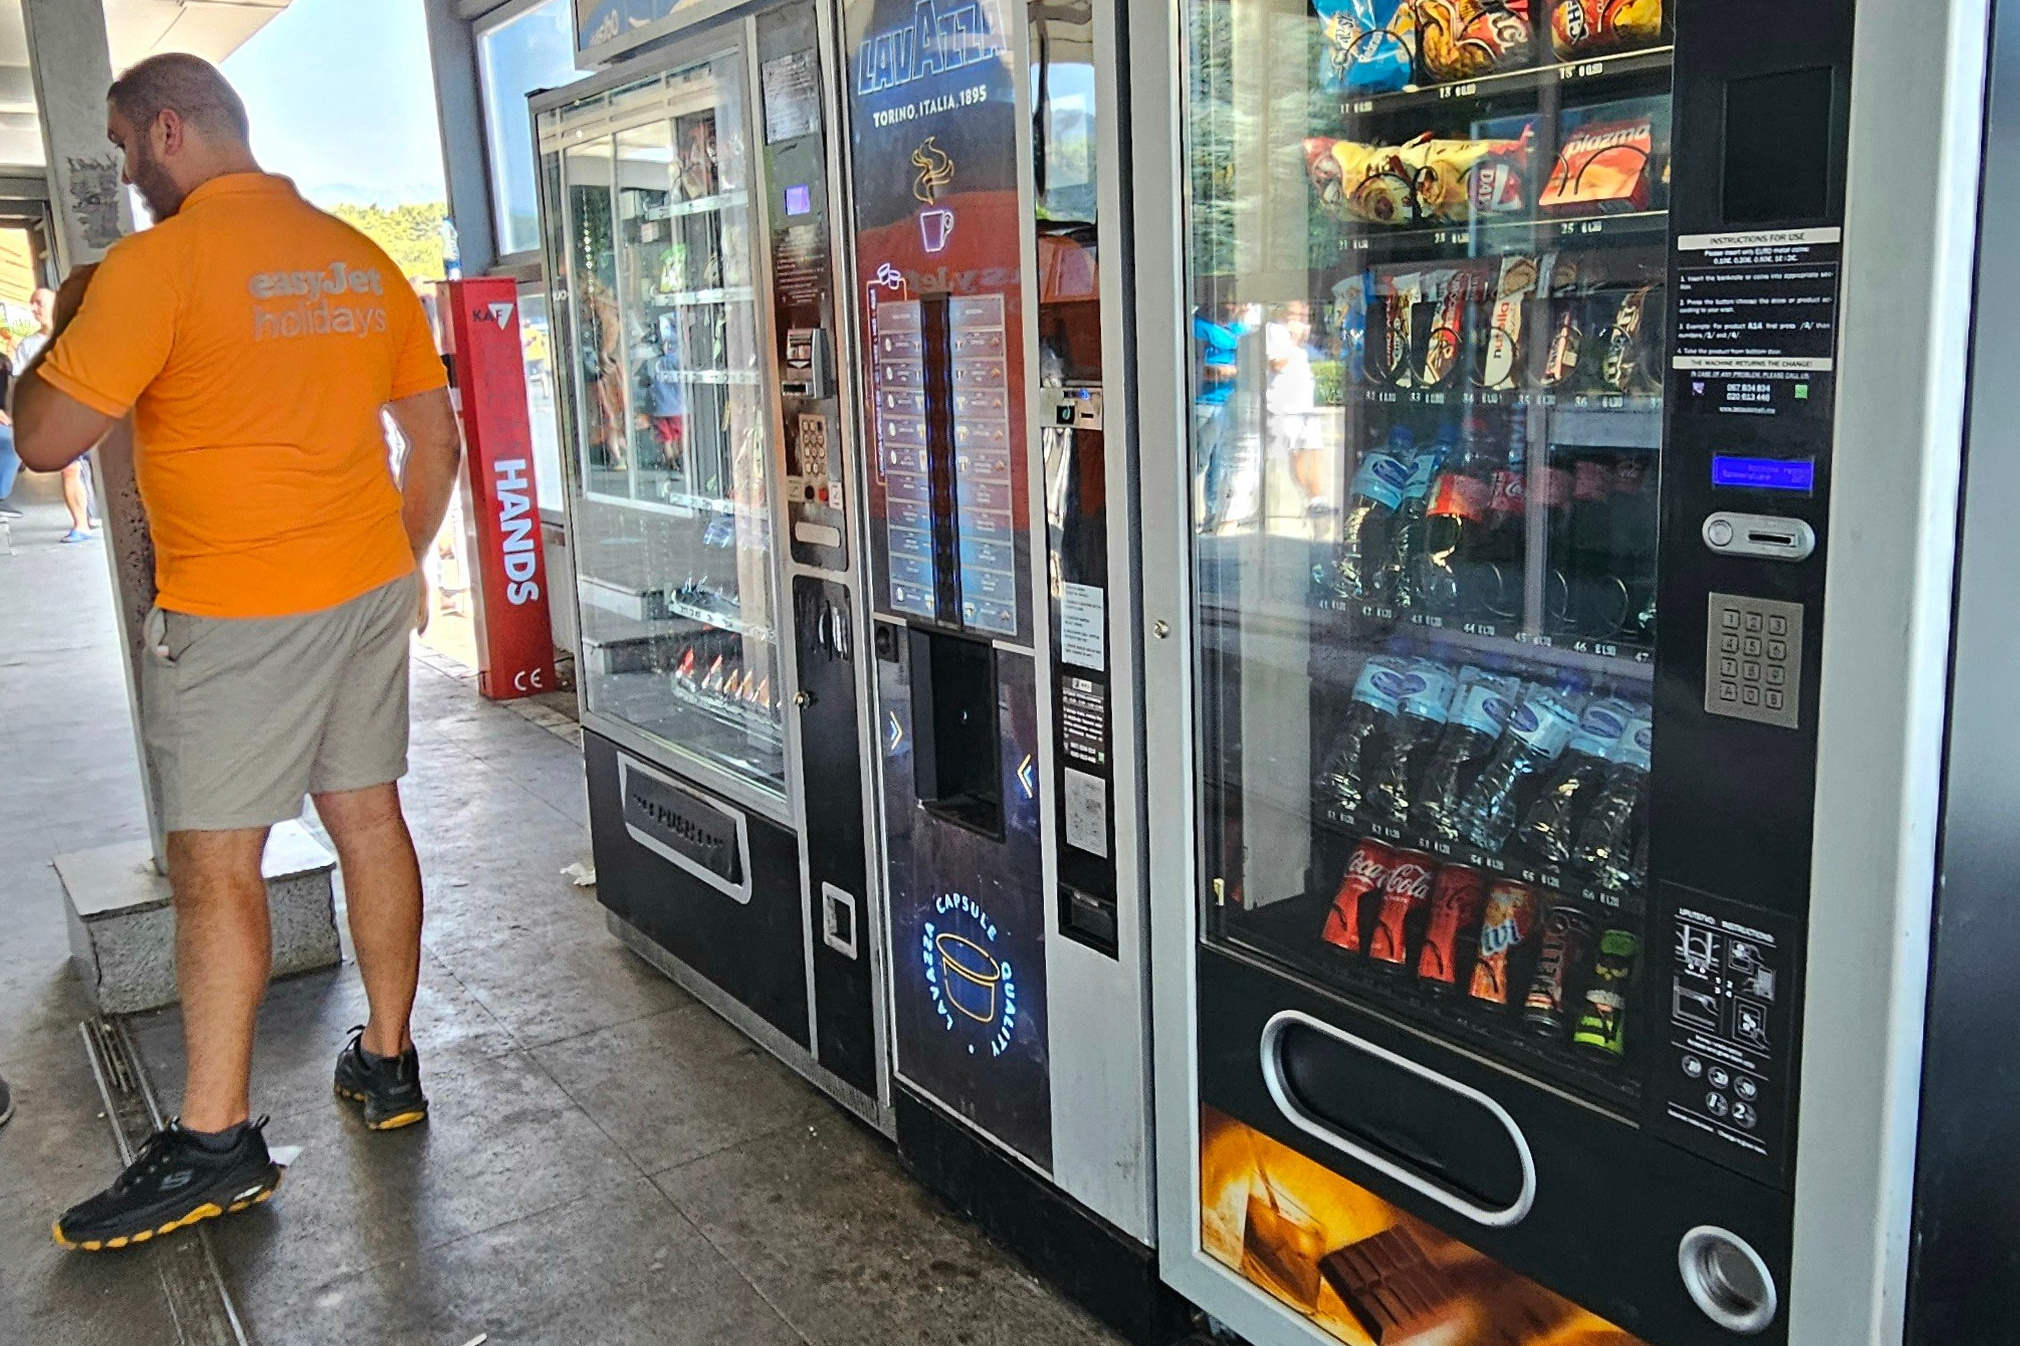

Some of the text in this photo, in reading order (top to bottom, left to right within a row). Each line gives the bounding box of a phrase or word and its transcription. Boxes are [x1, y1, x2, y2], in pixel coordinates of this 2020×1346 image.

[857, 0, 1008, 95] LAVAZZA
[960, 84, 987, 107] 1895
[1710, 232, 1804, 244] INSTRUCTIONS FOR USE
[249, 261, 384, 301] easyJet
[252, 298, 387, 342] holidays
[494, 458, 540, 606] HANDS
[514, 668, 543, 691] CE
[936, 893, 997, 941] CAPSULE
[923, 922, 953, 1030] LAVAZZA
[991, 961, 1016, 1057] QUALITY
